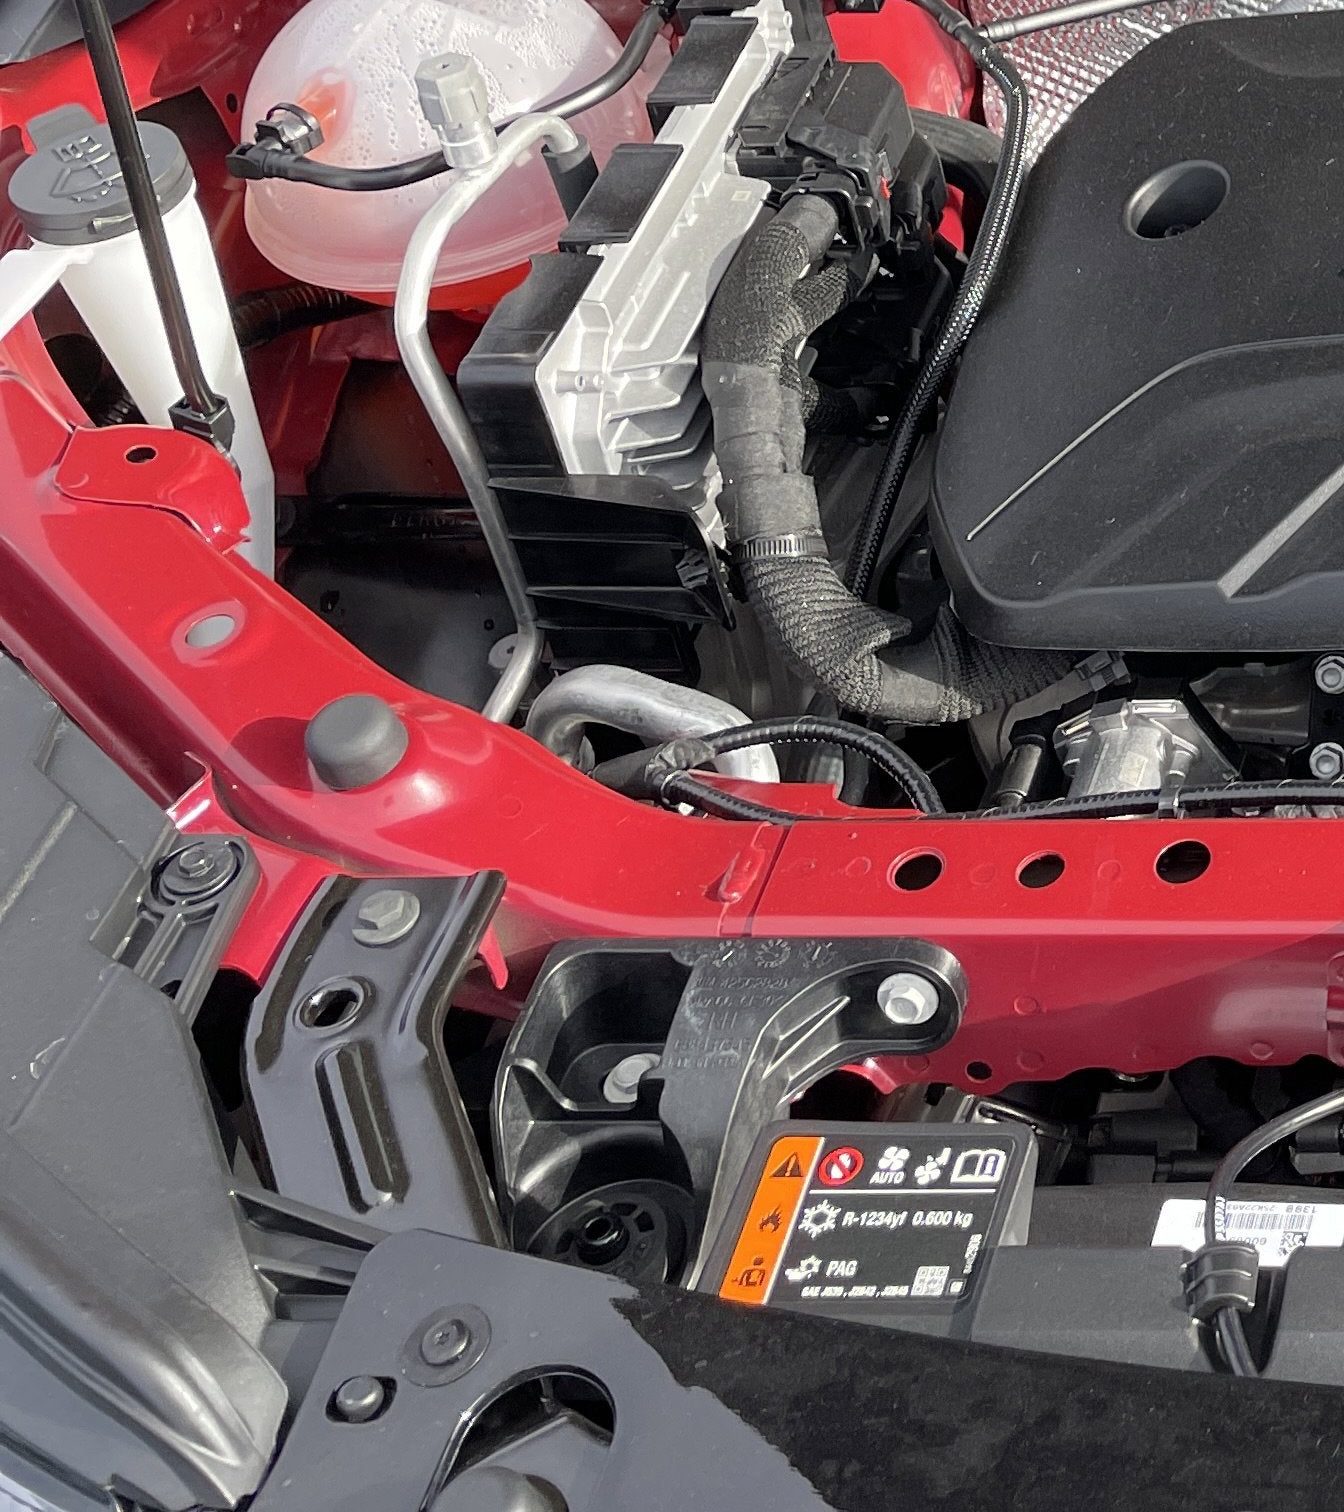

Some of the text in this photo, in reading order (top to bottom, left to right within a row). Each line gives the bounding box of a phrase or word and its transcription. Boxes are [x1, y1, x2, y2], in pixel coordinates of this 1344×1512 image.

[869, 1171, 906, 1185] AUTO
[842, 1211, 974, 1229] R-1234yf 0.600 kg
[825, 1260, 859, 1277] PAG
